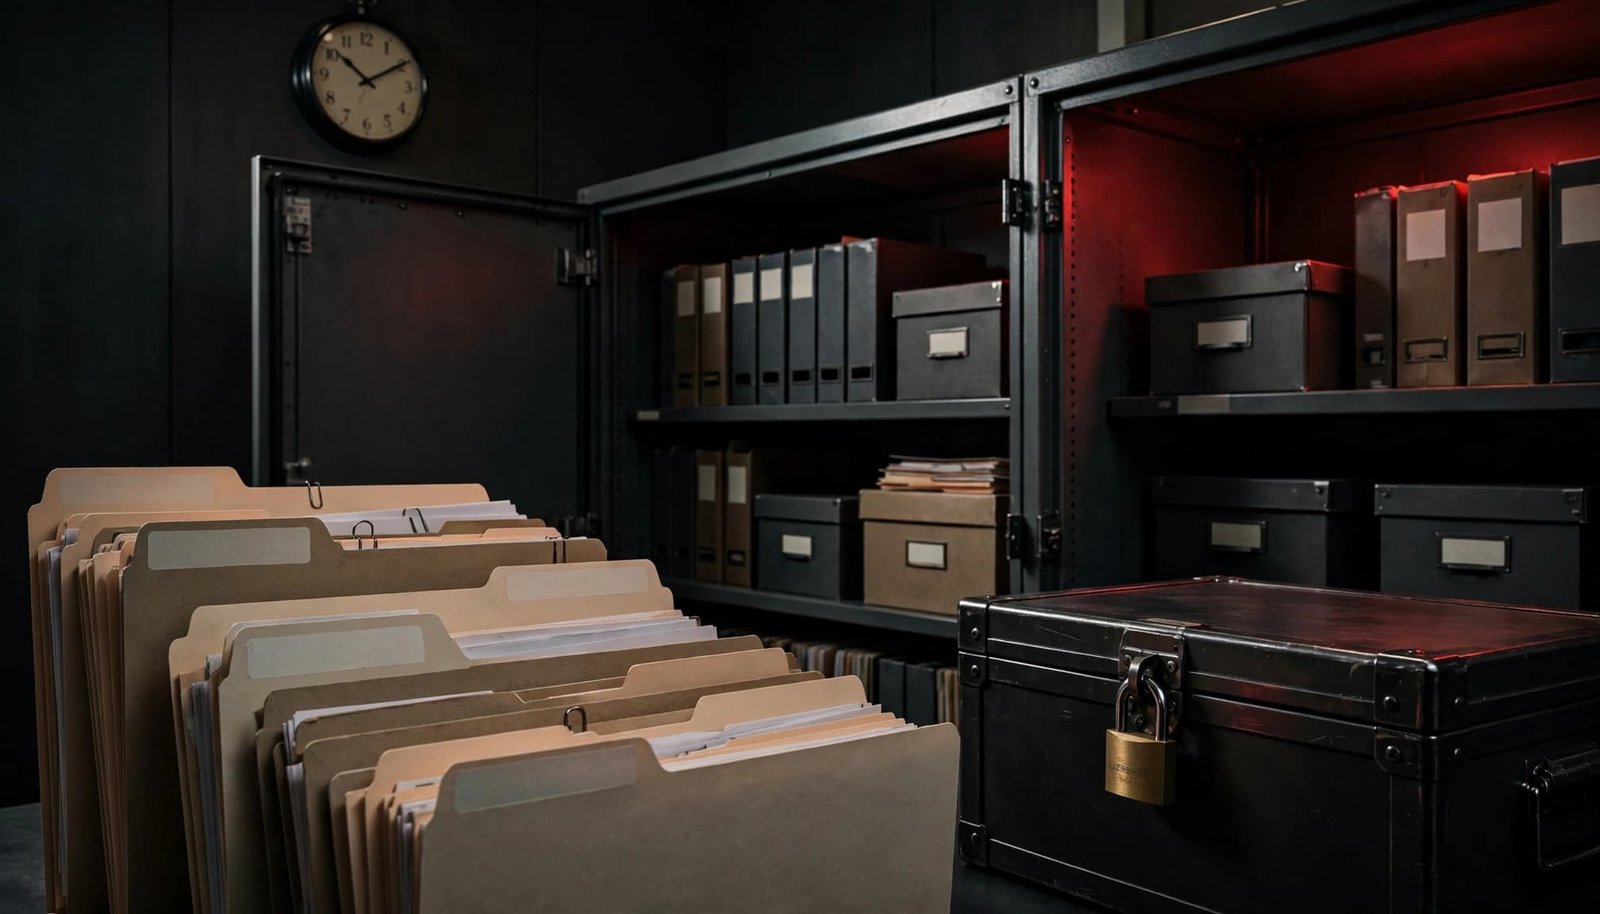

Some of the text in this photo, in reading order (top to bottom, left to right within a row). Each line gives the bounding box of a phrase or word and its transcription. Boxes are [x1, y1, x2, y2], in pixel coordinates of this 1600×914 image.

[341, 35, 352, 48] 11
[360, 32, 373, 47] 12
[326, 48, 339, 62] 10
[384, 41, 389, 55] 1
[320, 67, 329, 81] 9
[404, 80, 413, 94] 3
[326, 91, 335, 105] 8
[398, 101, 406, 114] 4
[343, 108, 351, 122] 7
[384, 114, 392, 128] 5
[362, 117, 372, 130] 6
